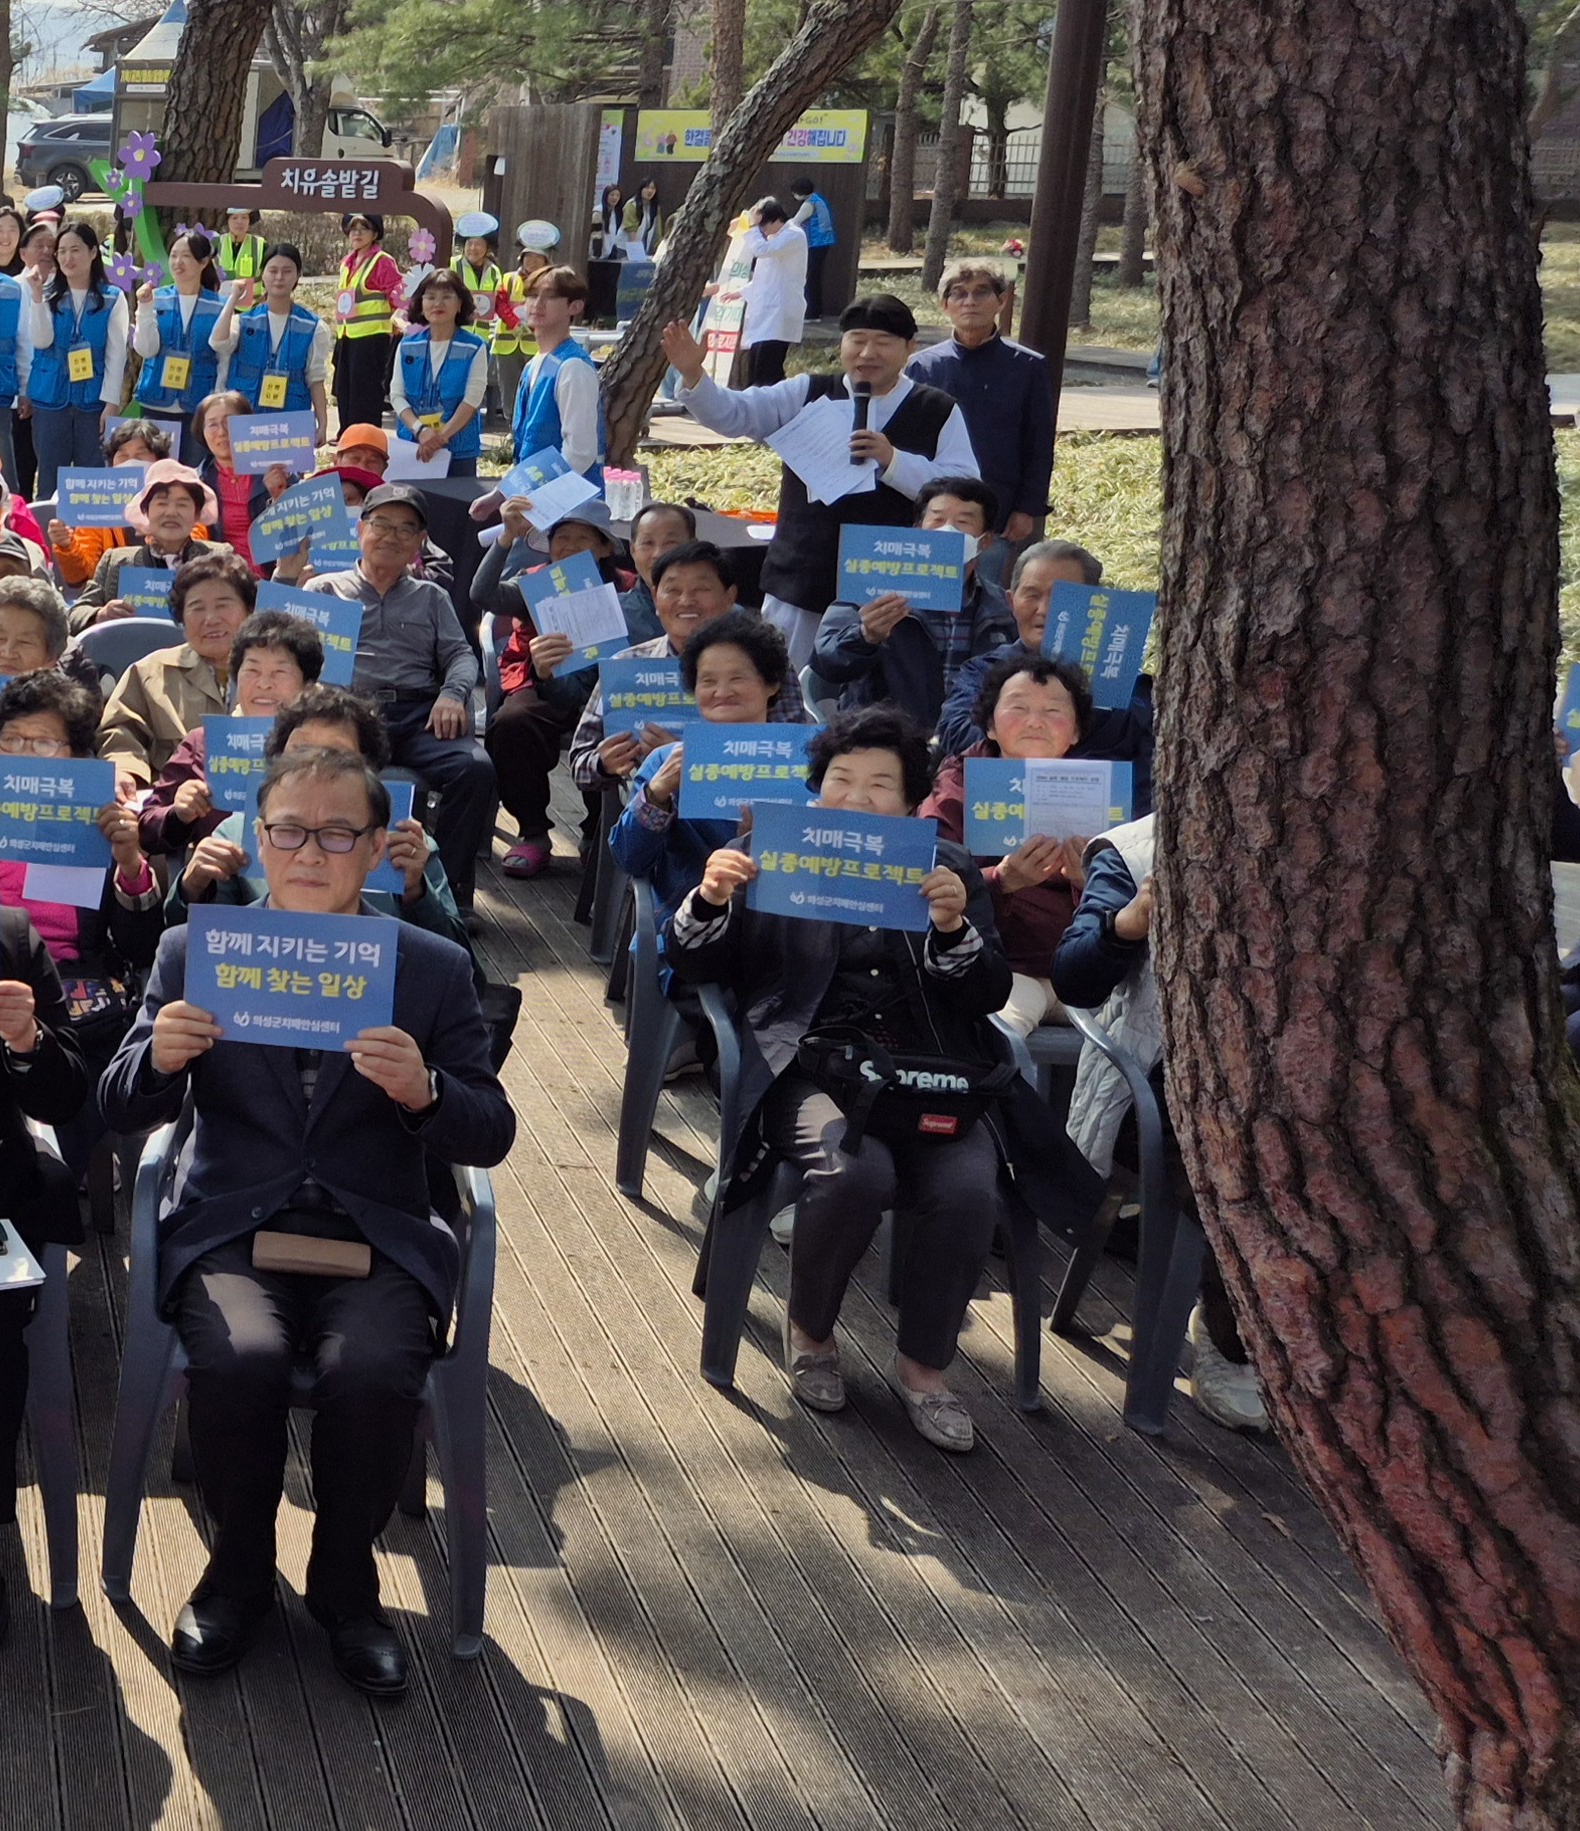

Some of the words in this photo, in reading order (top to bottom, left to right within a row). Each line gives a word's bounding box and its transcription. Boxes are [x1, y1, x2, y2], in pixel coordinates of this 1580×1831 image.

[787, 129, 846, 147] 건강해집니다
[281, 168, 379, 199] 치유솔밭길
[65, 478, 85, 490] 함께
[87, 479, 116, 490] 지키는
[119, 478, 138, 489] 기억
[275, 496, 311, 514] 지키는
[312, 487, 335, 501] 기억
[307, 503, 332, 521] 일상
[874, 541, 931, 558] 치매극복
[844, 557, 957, 579] 실종예방프로젝트
[634, 672, 680, 687] 치매극
[723, 741, 793, 758] 치매극복
[688, 763, 812, 781] 실종예방프로젝
[4, 775, 74, 798] 치매극복
[801, 827, 884, 858] 치매극복
[758, 849, 925, 887] 실종예방프로젝트
[206, 929, 252, 955] 함께
[257, 936, 328, 963] 지키는
[335, 942, 380, 967] 기억
[215, 963, 261, 989] 함께
[267, 968, 313, 994] 찾는
[318, 973, 367, 999] 일상
[252, 1015, 340, 1033] 의성군치매안심센터
